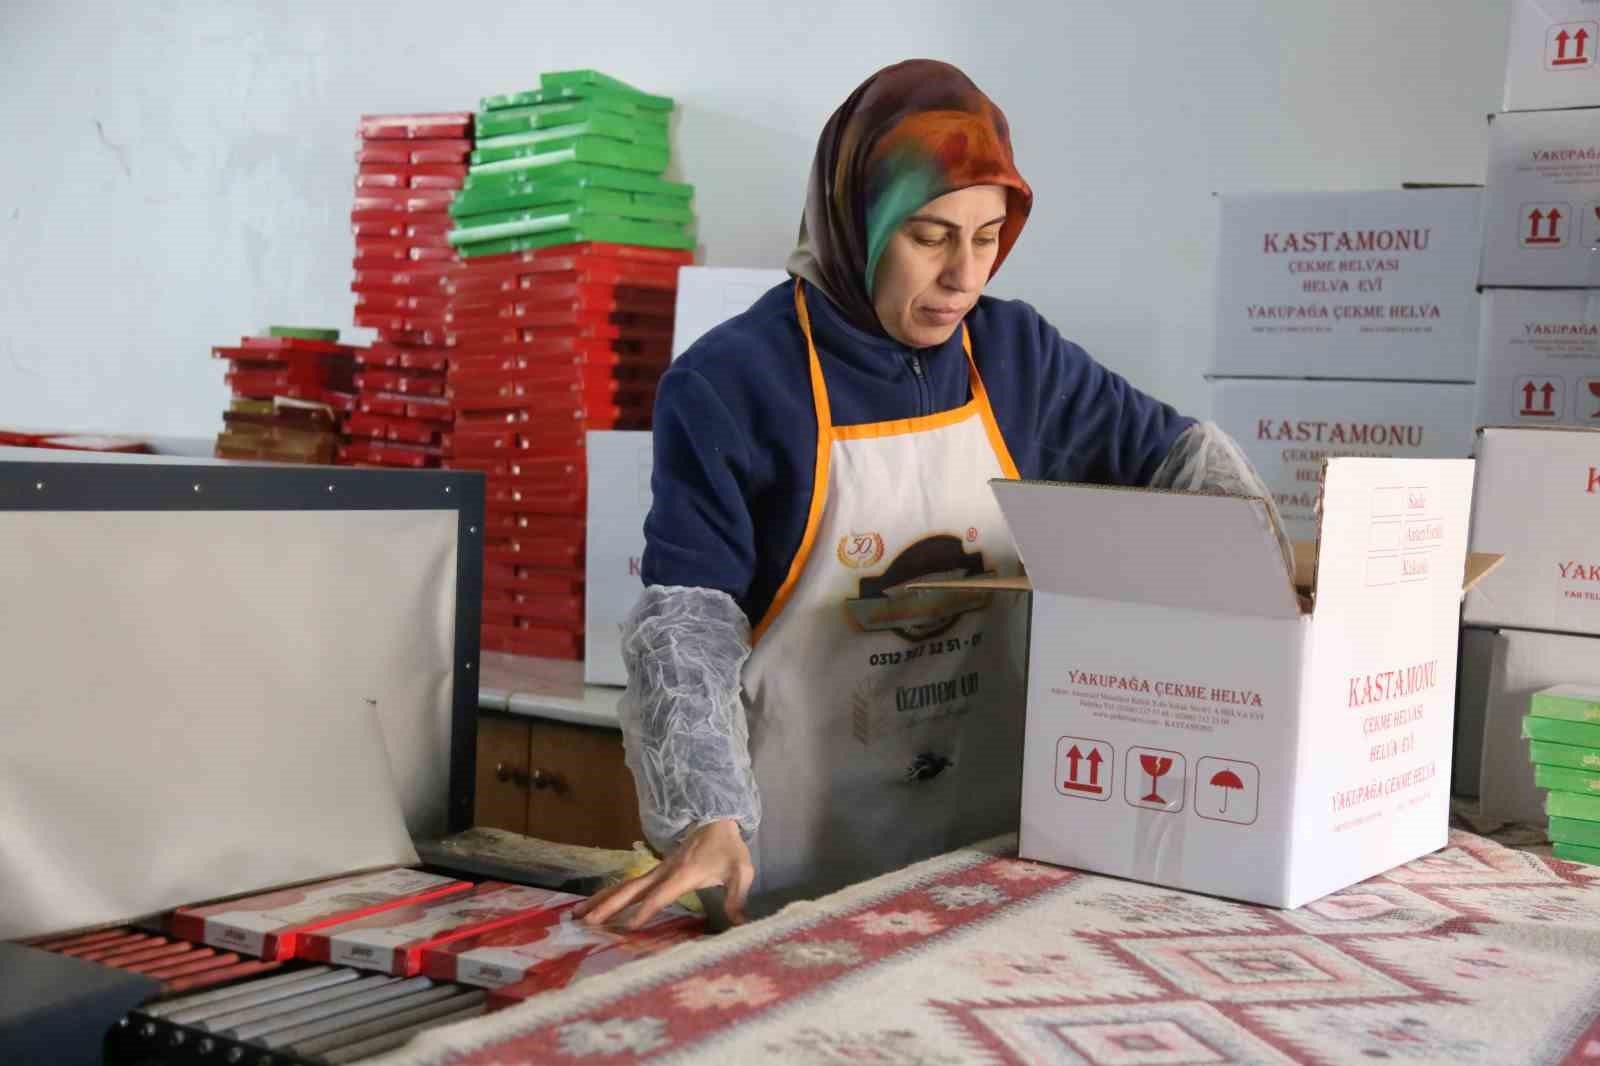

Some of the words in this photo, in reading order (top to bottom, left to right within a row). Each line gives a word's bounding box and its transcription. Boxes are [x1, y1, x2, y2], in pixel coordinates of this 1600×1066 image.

[1264, 229, 1430, 253] KASTAMONU
[1288, 260, 1335, 274] ÇEKME
[1303, 279, 1349, 292] HELVA
[1247, 303, 1328, 319] YAKUPAĞA
[1333, 304, 1385, 323] ÇEKME
[1389, 304, 1440, 319] HELVA
[1257, 419, 1424, 447] KASTAMONU
[870, 652, 901, 666] 0312
[1067, 669, 1149, 693] YAKUPAĞA
[1154, 681, 1206, 700] ÇEKME
[1210, 687, 1263, 707] HELVA
[1348, 659, 1438, 708] KASTAMONU
